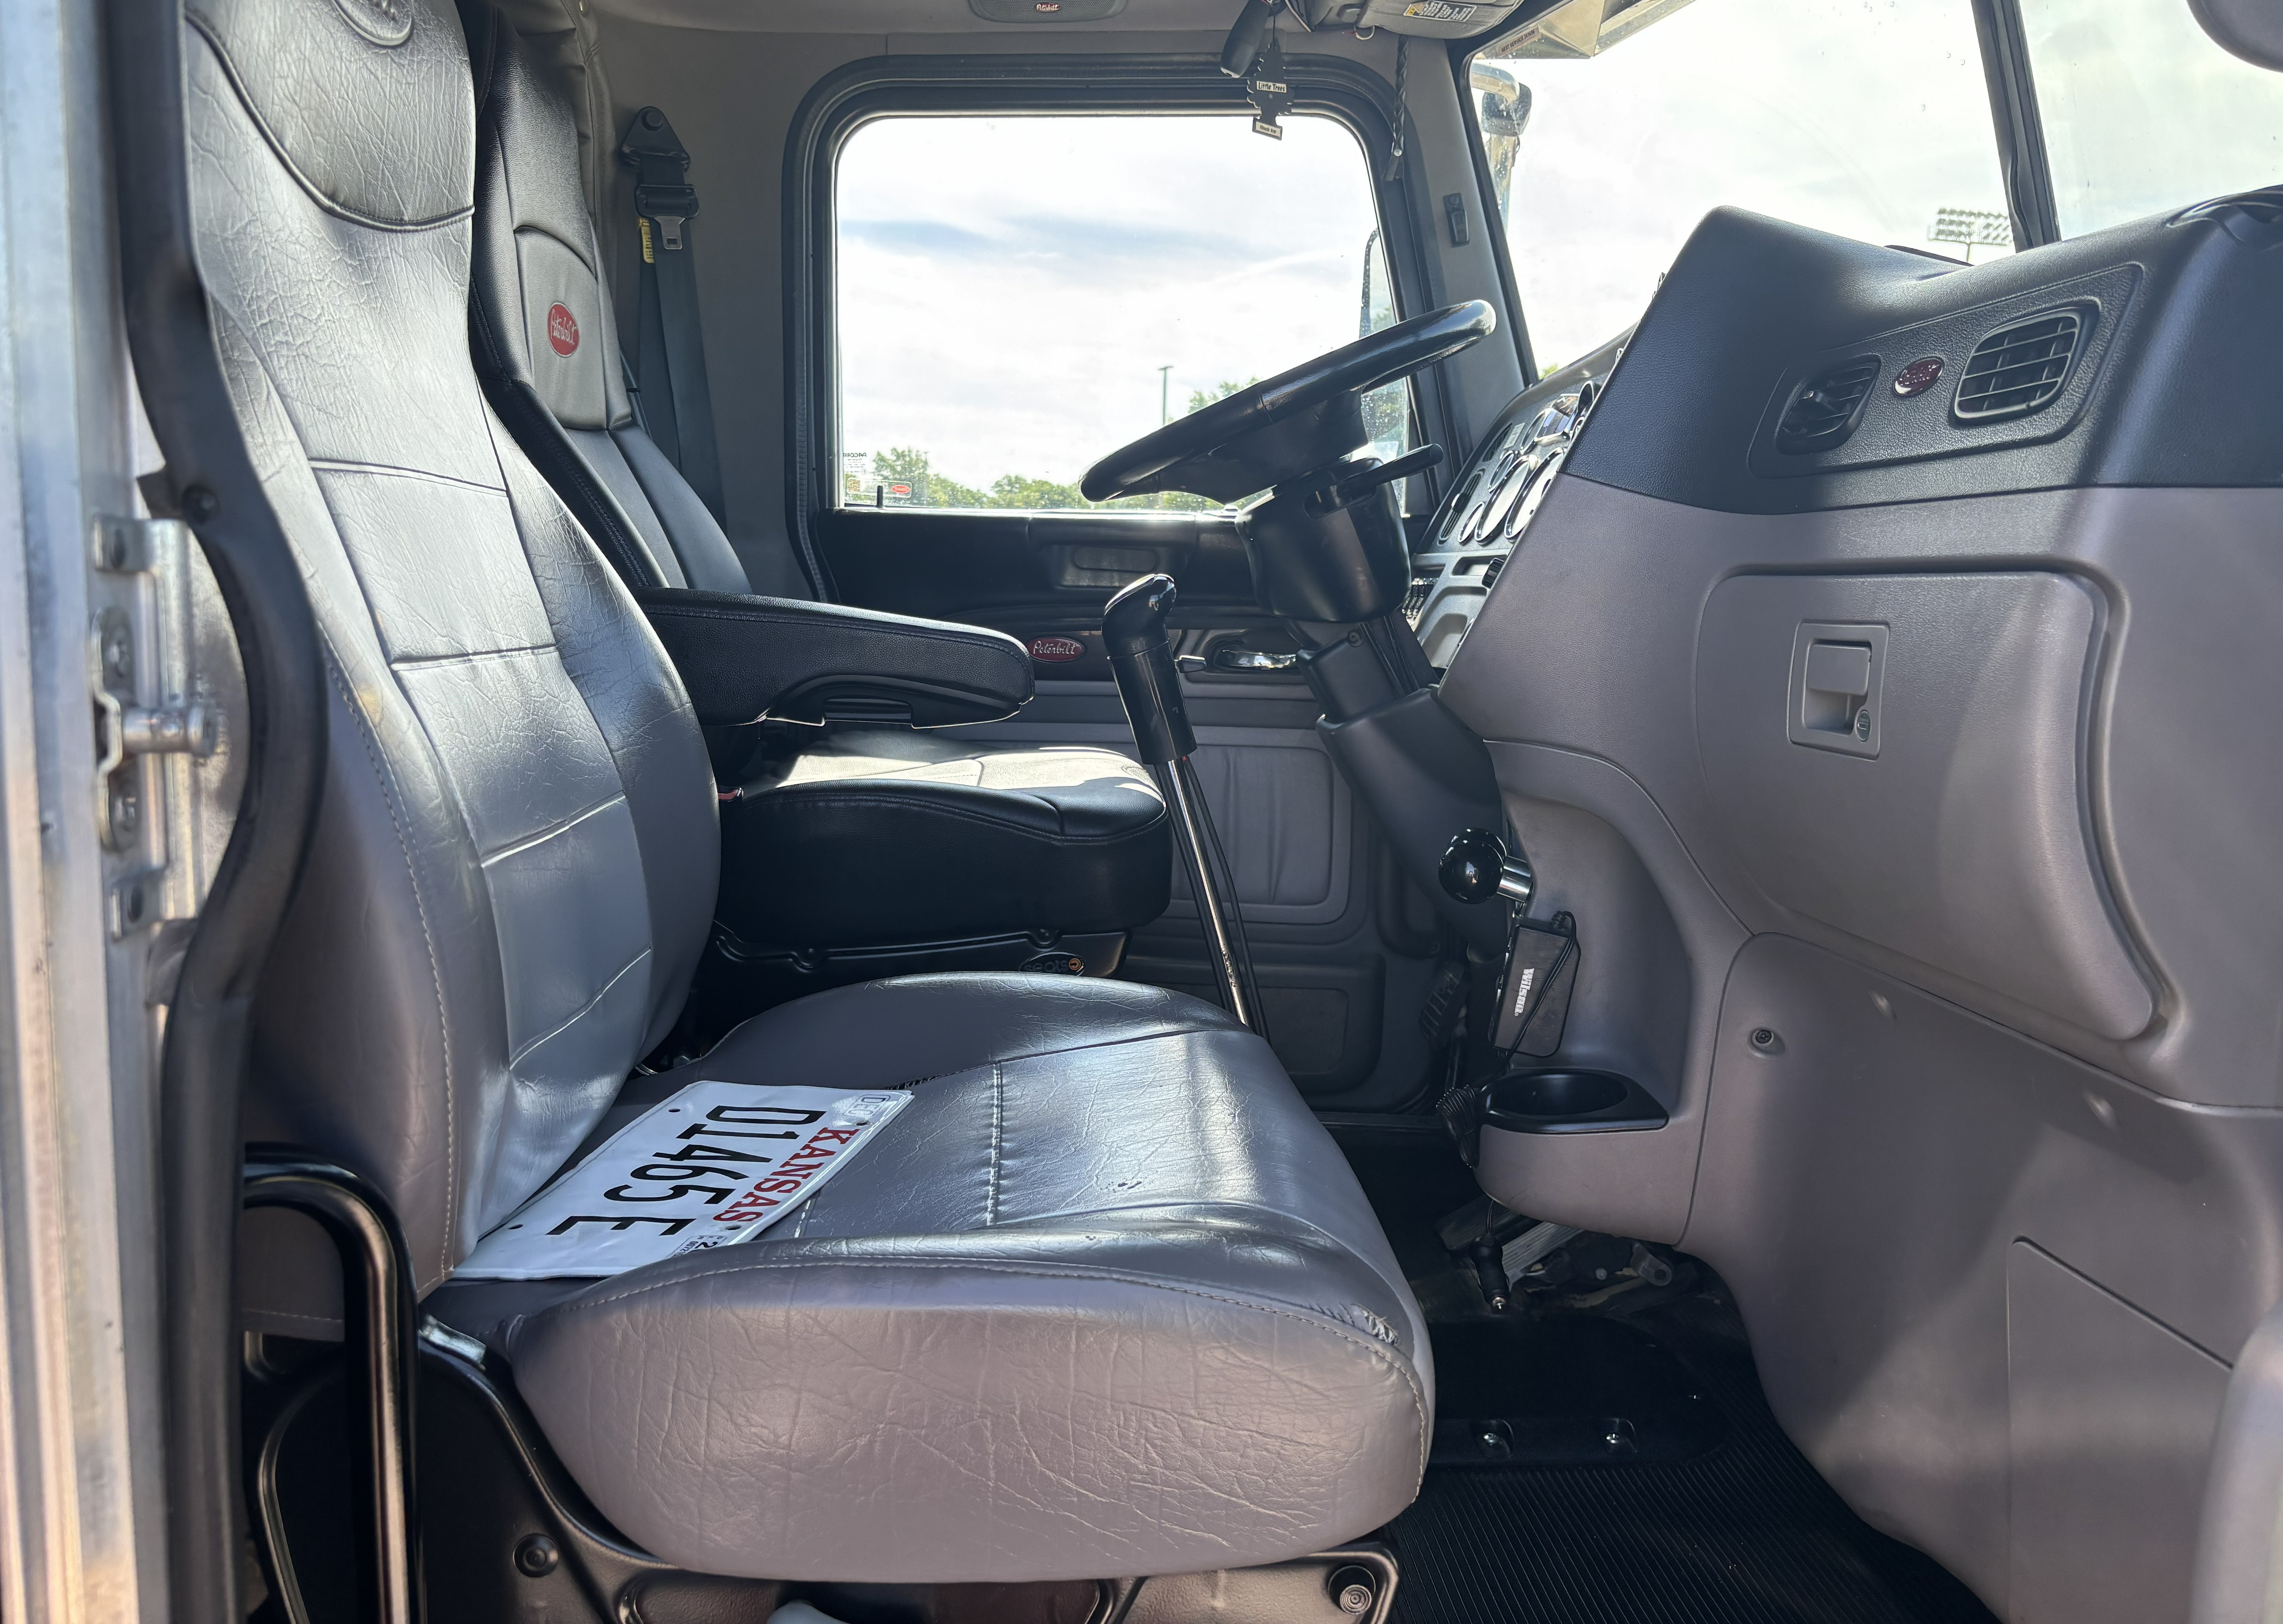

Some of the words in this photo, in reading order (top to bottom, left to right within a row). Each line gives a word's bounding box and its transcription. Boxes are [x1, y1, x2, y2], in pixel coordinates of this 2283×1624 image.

[1259, 82, 1271, 90] Little
[1272, 83, 1285, 92] Trees
[1033, 641, 1080, 654] Peterbilt
[1514, 968, 1534, 1013] Wilson
[604, 1105, 827, 1205] D1465
[713, 1127, 861, 1222] KANSAS
[545, 1216, 697, 1236] E
